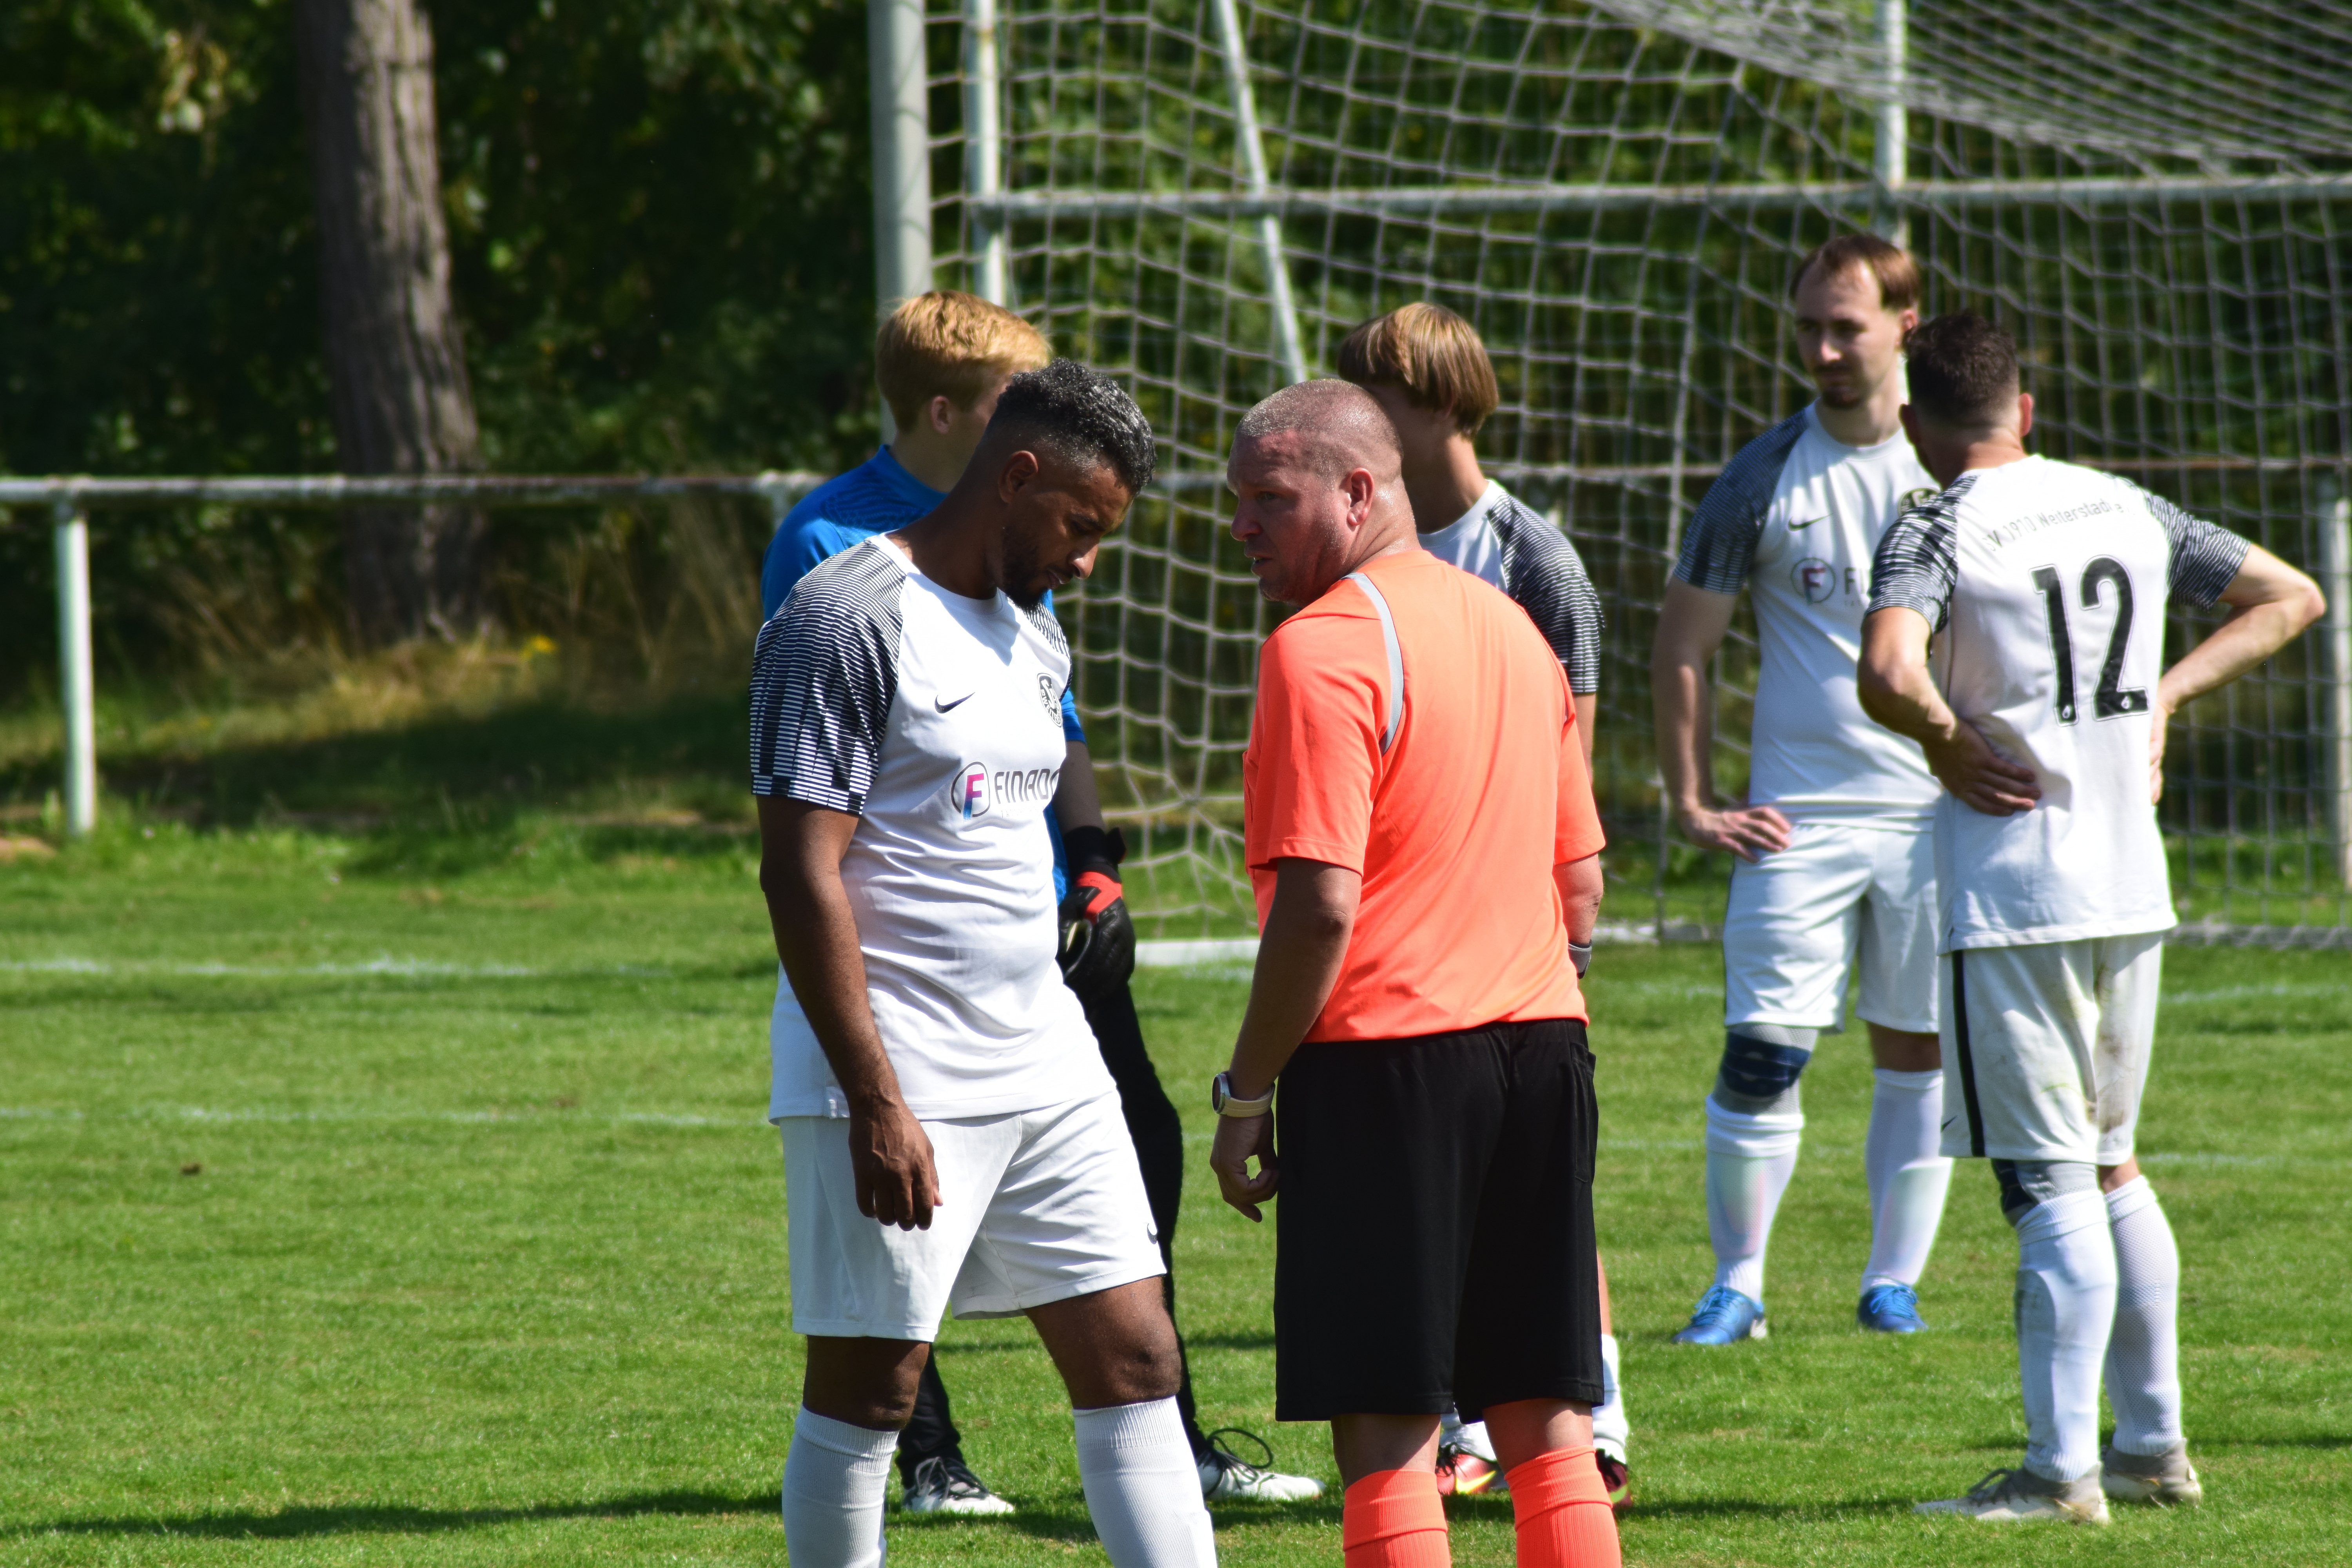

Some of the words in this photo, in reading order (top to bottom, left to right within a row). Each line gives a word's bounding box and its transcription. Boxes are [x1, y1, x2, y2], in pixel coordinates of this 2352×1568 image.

[2002, 516, 2037, 541] 1910
[1802, 567, 1826, 605] F
[2028, 555, 2149, 727] 12
[963, 773, 984, 820] F
